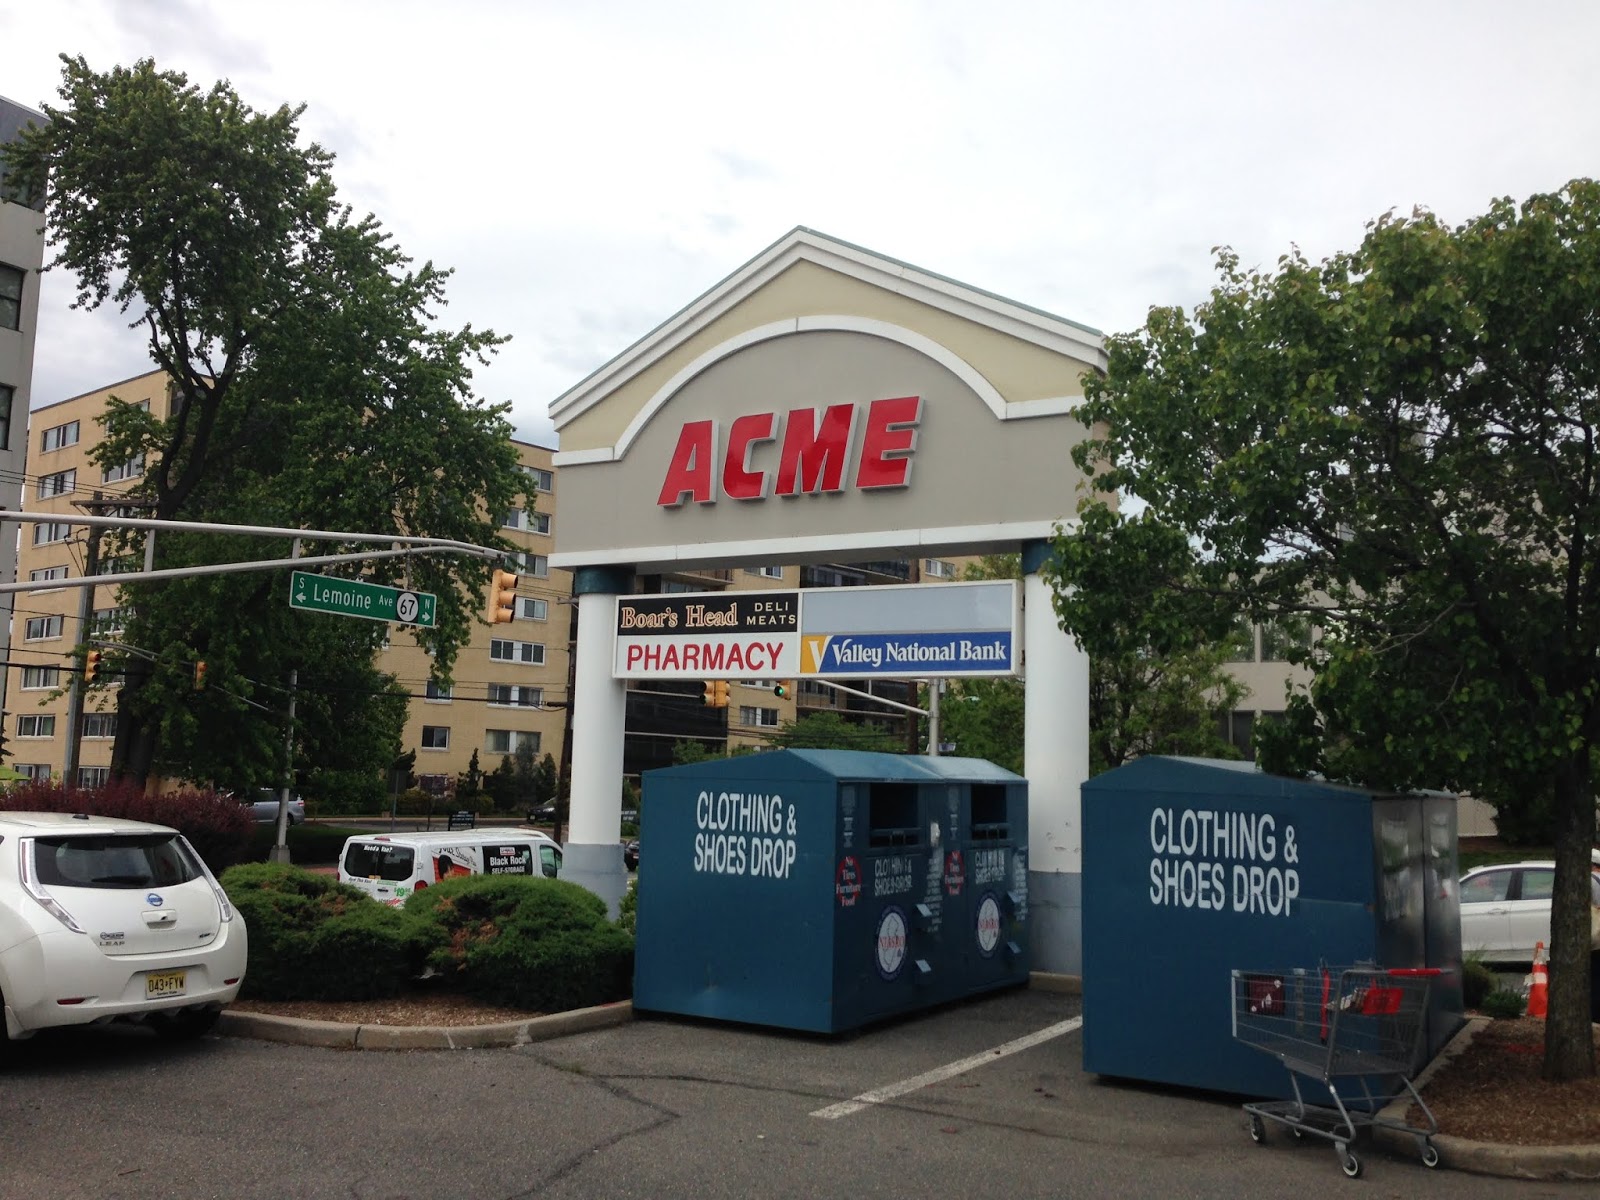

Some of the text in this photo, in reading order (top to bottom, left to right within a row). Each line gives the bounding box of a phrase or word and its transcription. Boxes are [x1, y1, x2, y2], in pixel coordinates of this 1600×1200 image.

[656, 396, 924, 506] ACME
[299, 577, 305, 589] S
[313, 584, 393, 609] Lemoine Ave
[400, 600, 415, 615] 67
[424, 599, 431, 610] N
[755, 602, 788, 612] DELI
[620, 602, 738, 628] Boar's Head
[746, 615, 796, 625] MEATS
[627, 642, 783, 670] PHARMACY
[832, 639, 1006, 667] Valley National Bank
[696, 791, 797, 836] CLOTHING &
[1150, 807, 1299, 864] CLOTHING &
[490, 855, 526, 866] Black Rock
[694, 833, 796, 879] SHOES DROP
[1150, 858, 1300, 917] SHOES DROP
